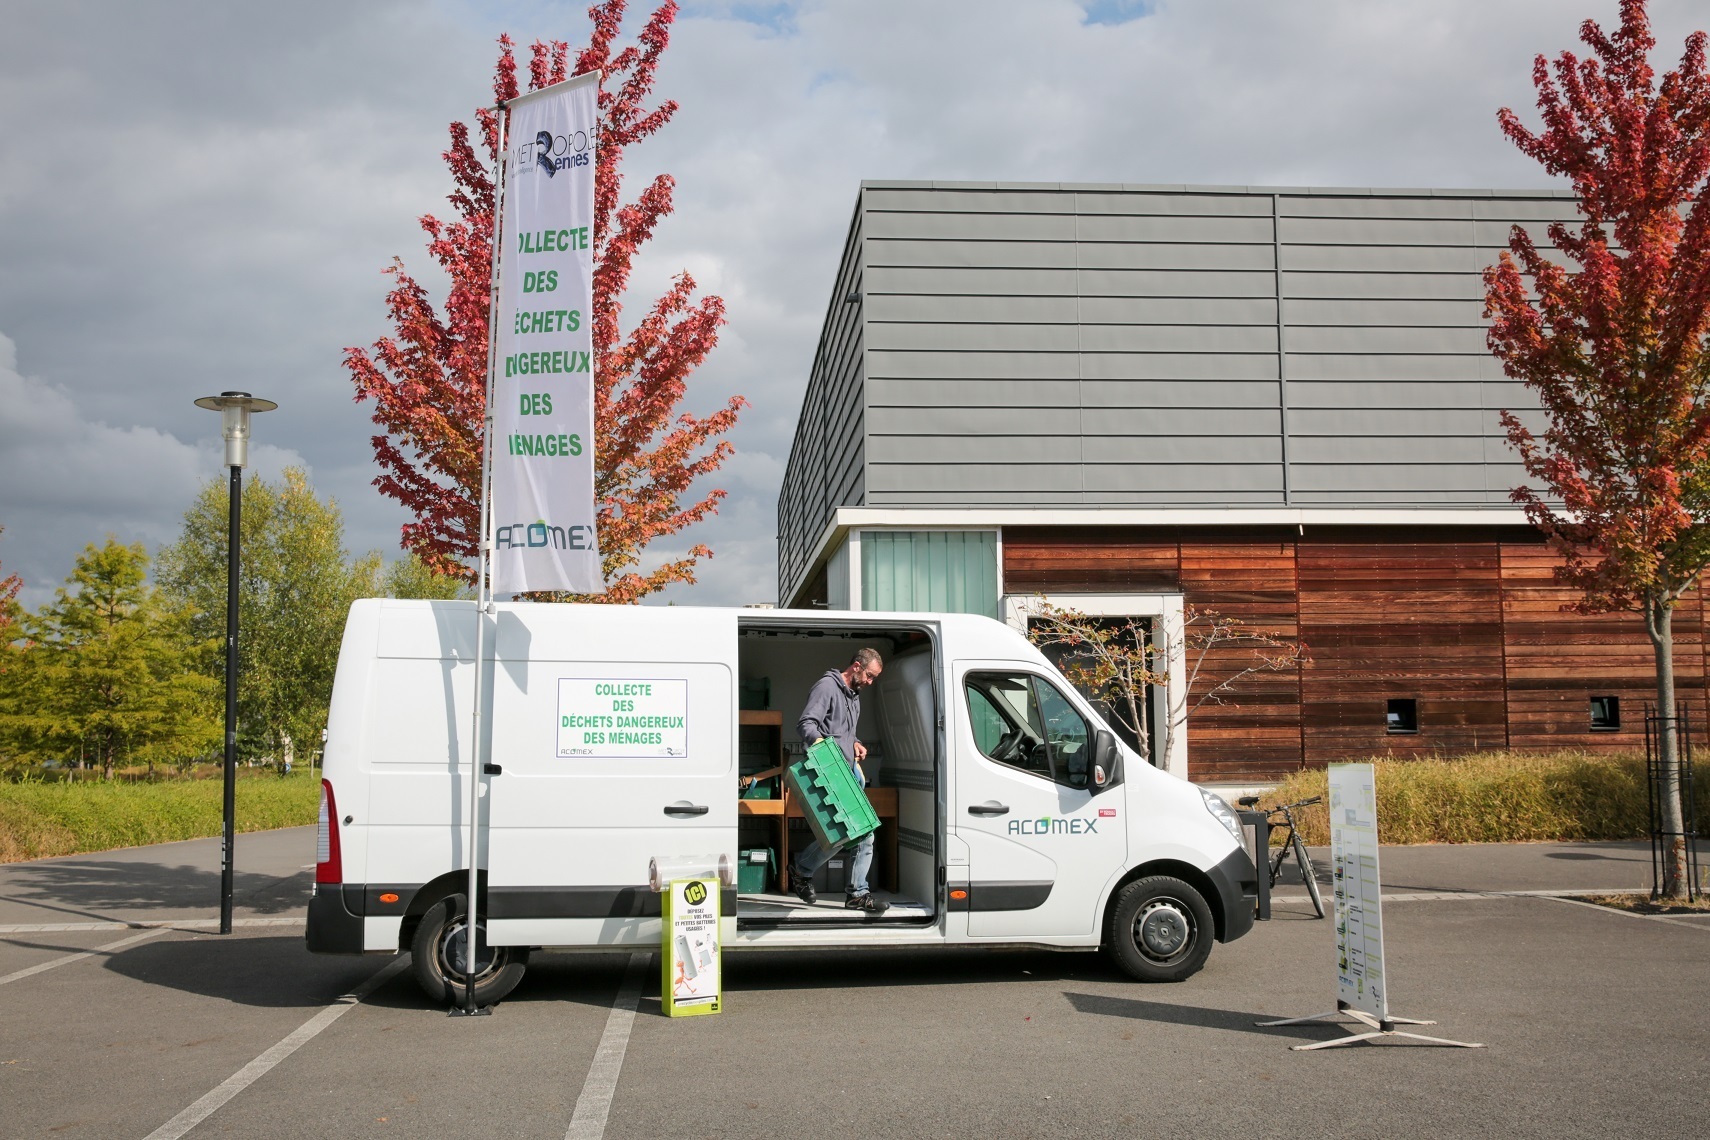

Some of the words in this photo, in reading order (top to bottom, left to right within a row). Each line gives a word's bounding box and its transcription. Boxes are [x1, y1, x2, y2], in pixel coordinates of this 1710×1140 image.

[518, 226, 589, 254] LLECTE
[523, 270, 559, 293] DES
[514, 307, 581, 335] ÉCHETS
[505, 350, 590, 378] NGEREUX
[520, 392, 553, 416] DES
[595, 683, 652, 696] COLLECTE
[612, 699, 634, 712] DES
[561, 713, 613, 728] DÉCHETS
[616, 716, 684, 728] DANGEREUX
[583, 732, 605, 744] DES
[608, 730, 662, 744] MÉNAGES
[1008, 817, 1098, 835] ACOMEX
[685, 883, 706, 904] ICI
